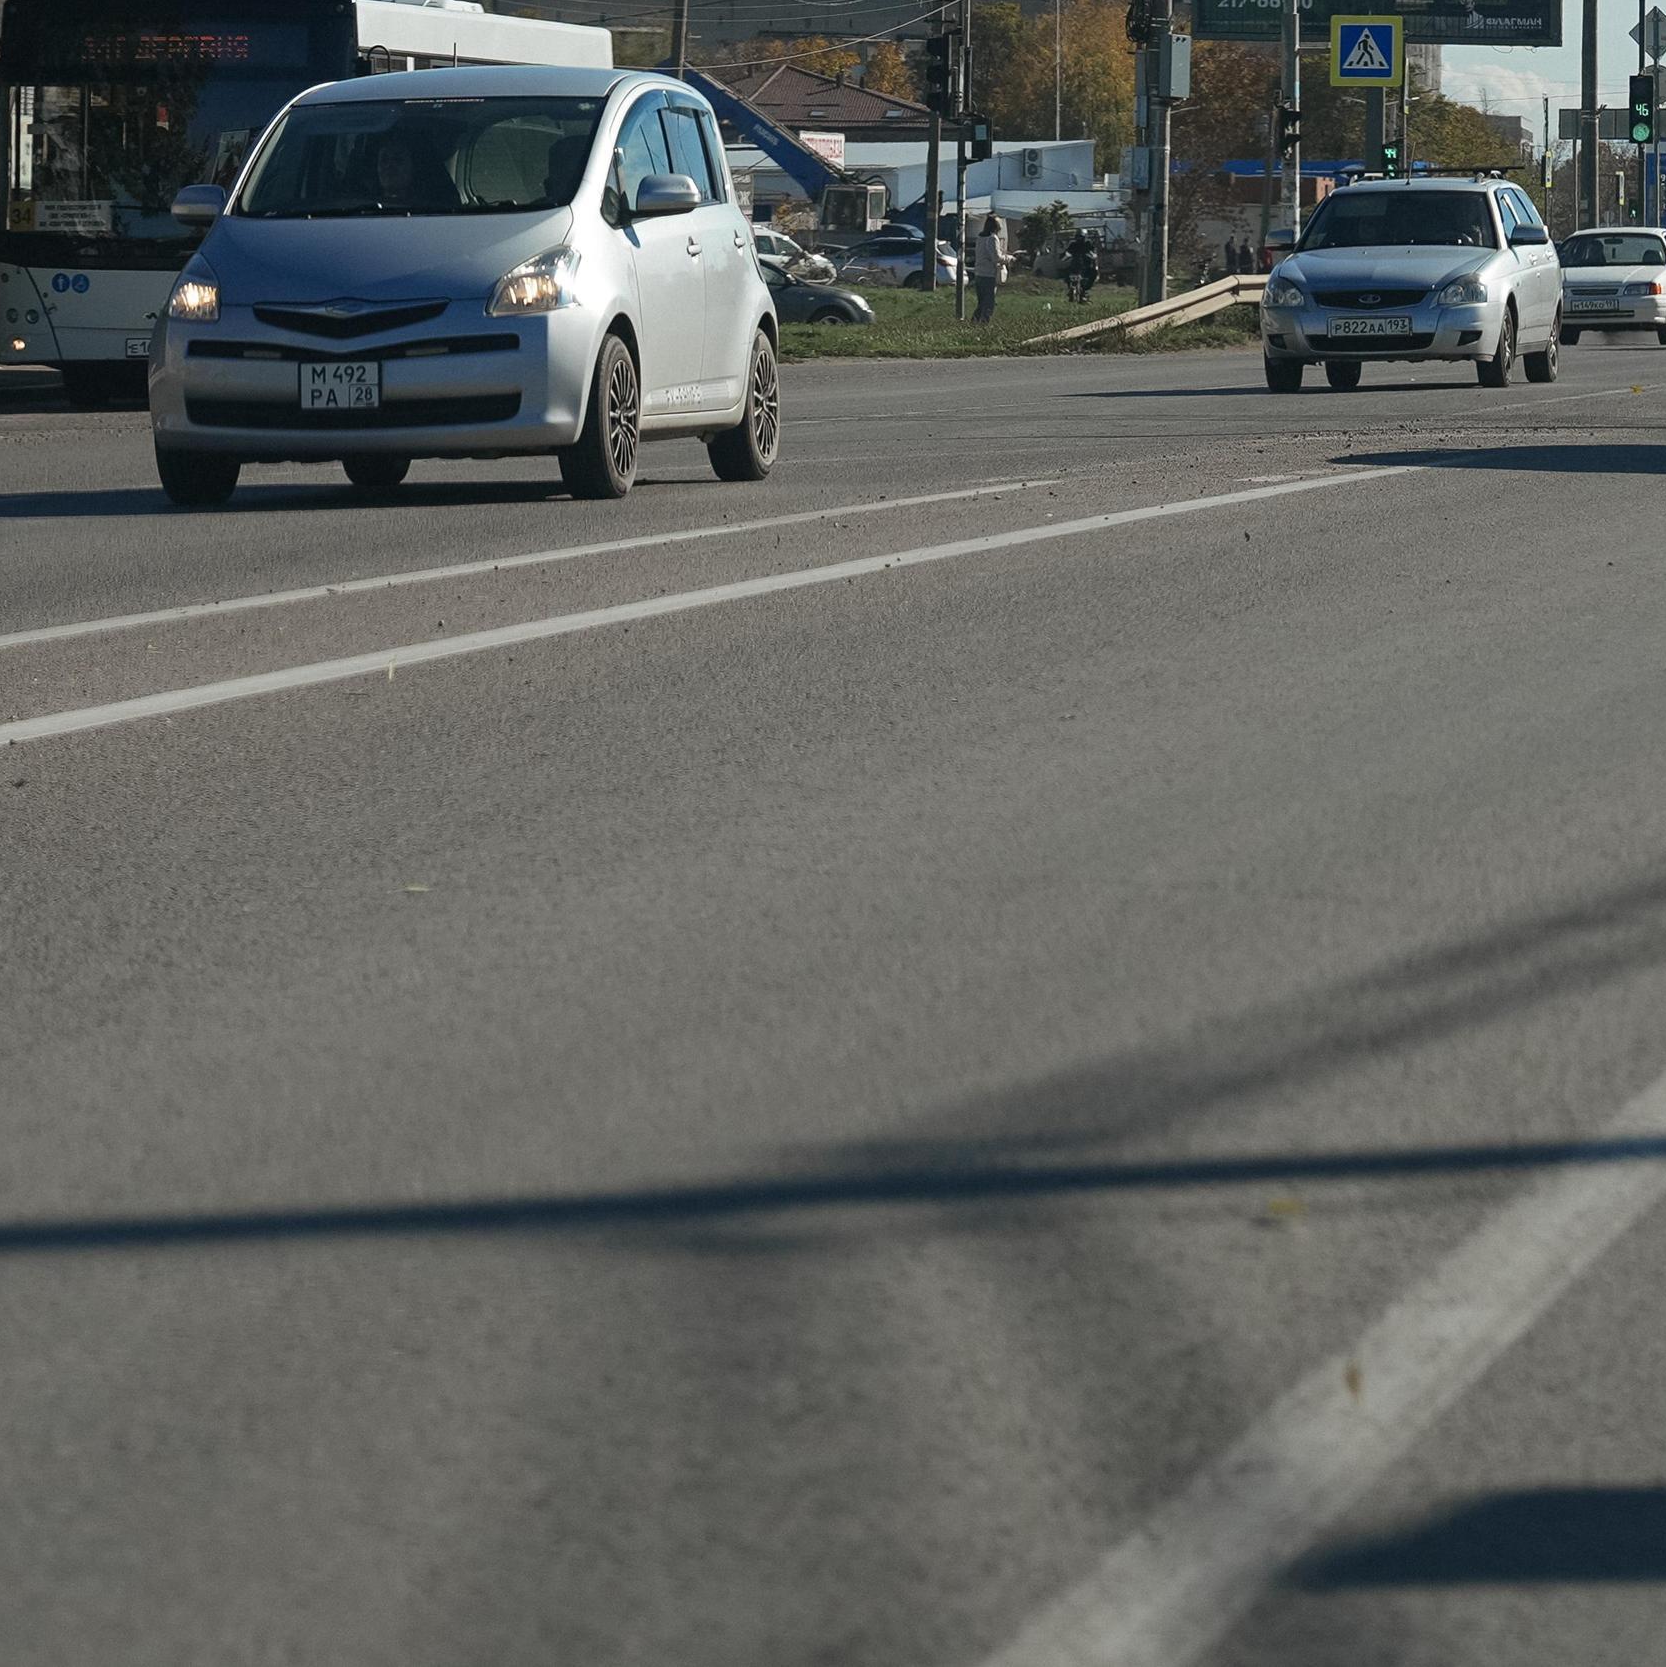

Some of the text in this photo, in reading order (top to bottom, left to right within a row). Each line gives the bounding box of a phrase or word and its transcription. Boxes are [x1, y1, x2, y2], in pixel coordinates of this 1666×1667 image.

[1635, 103, 1649, 116] 46
[1387, 319, 1407, 330] 193
[355, 386, 373, 401] 28
